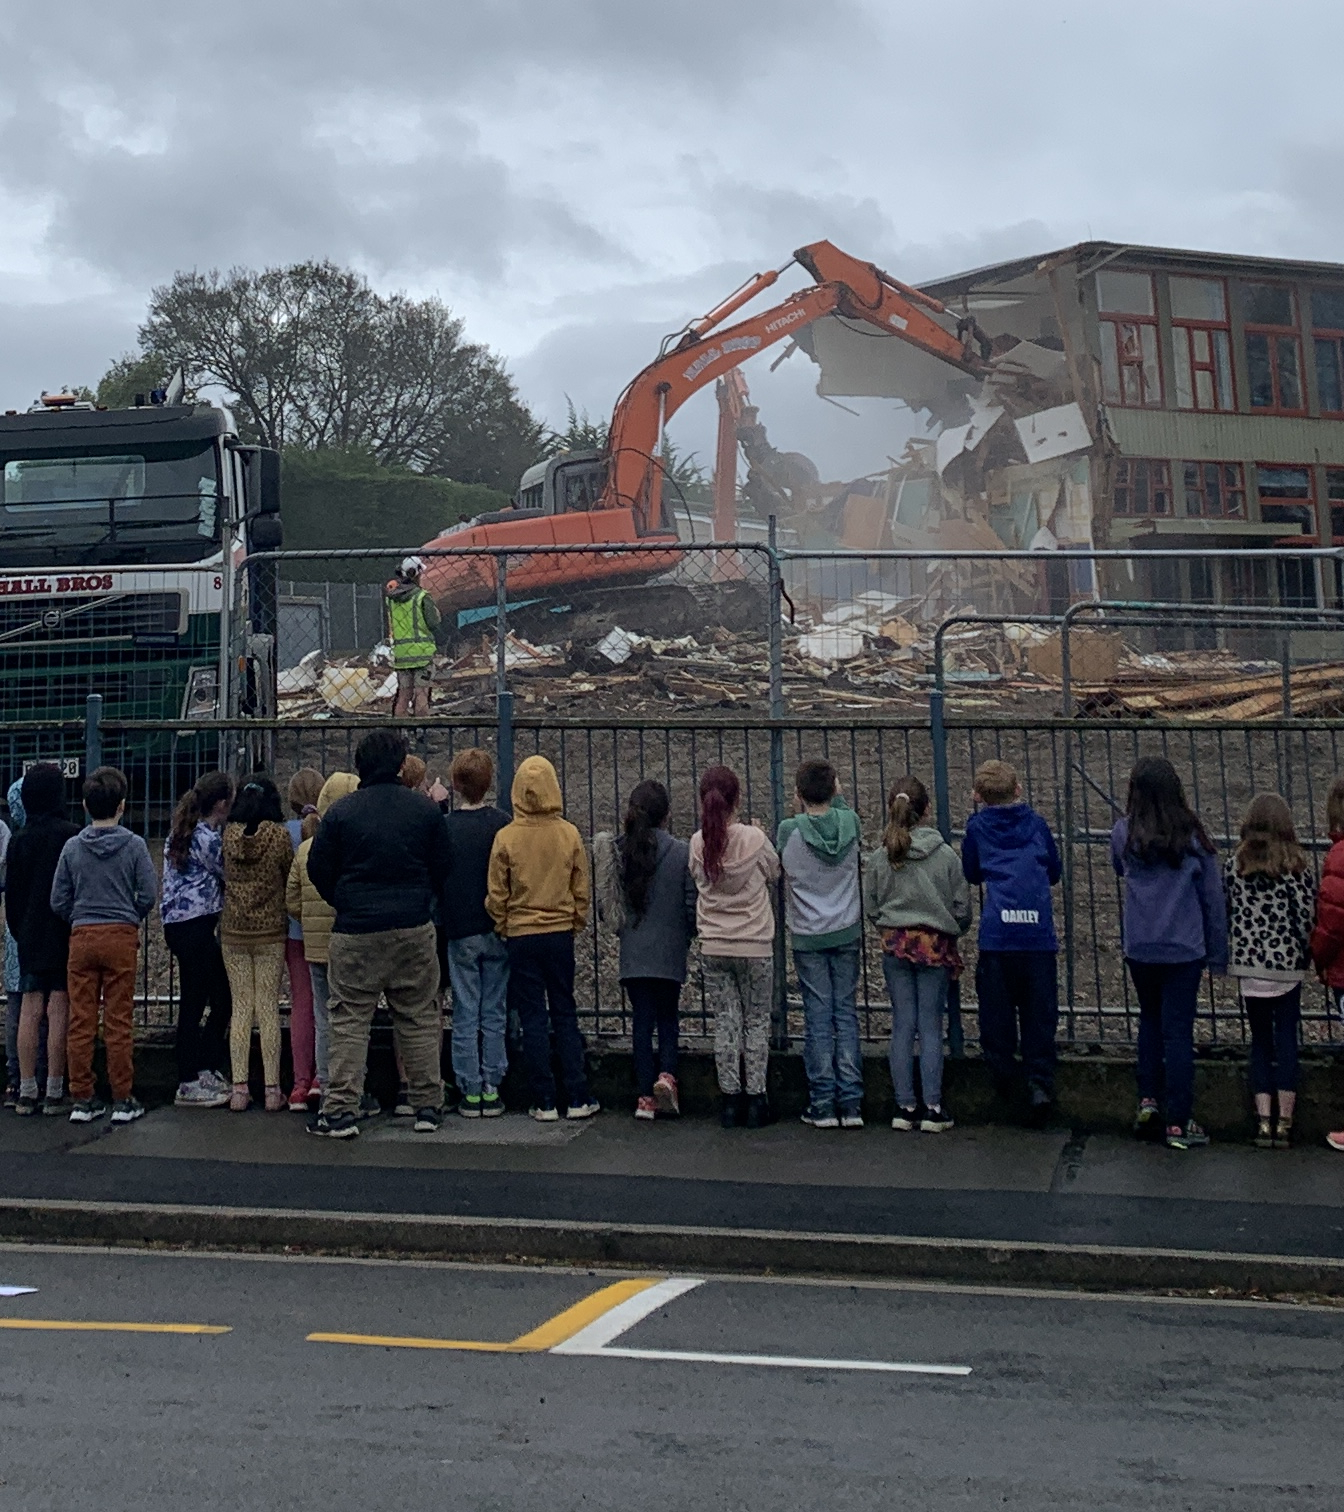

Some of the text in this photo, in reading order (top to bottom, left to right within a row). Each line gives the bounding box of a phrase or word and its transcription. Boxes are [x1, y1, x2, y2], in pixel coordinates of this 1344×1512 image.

[765, 308, 807, 334] HITACHI
[56, 574, 113, 592] BROS
[1001, 909, 1039, 923] OAKLEY
